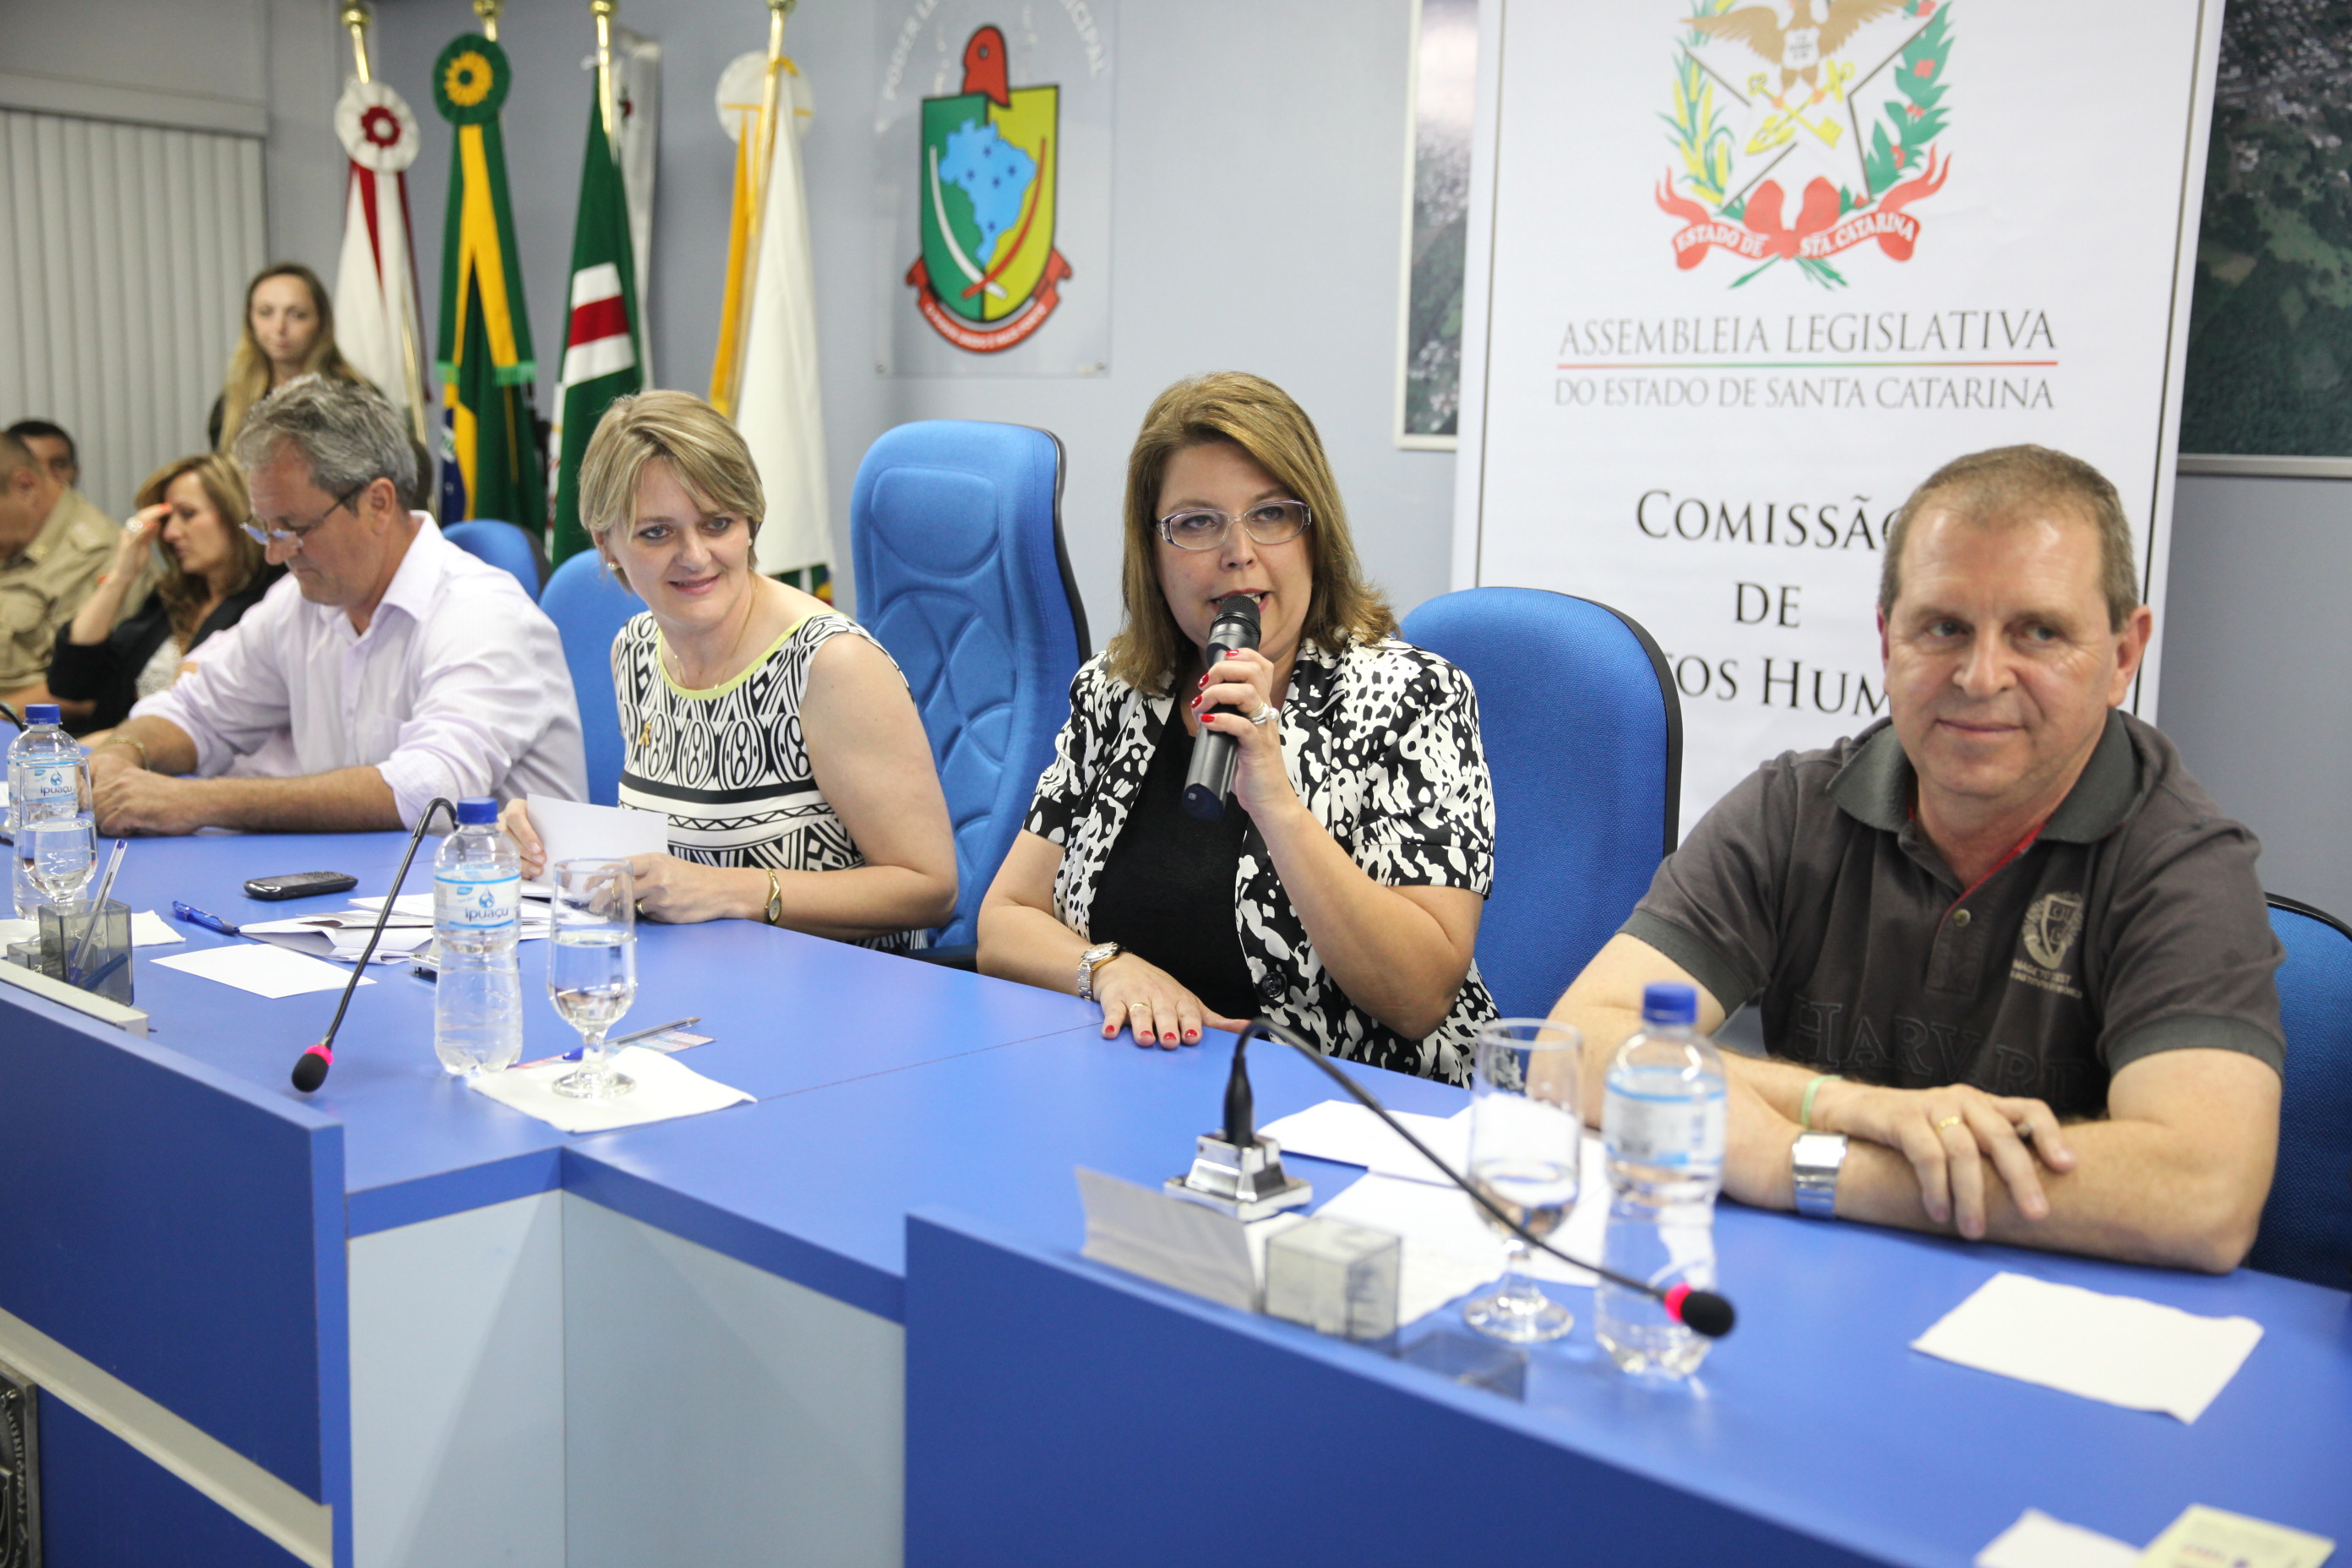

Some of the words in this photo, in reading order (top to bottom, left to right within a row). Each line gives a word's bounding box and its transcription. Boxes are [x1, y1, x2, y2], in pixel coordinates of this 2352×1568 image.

[1675, 223, 1740, 253] ESTADO
[1740, 235, 1766, 258] DE
[1835, 212, 1916, 247] CATARINA
[1558, 316, 1770, 357] ASSEMBLEIA
[1784, 308, 2059, 355] LEGISLATIVA
[1554, 378, 1596, 408] DO
[1603, 378, 1710, 408] ESTADO
[1718, 378, 1757, 409] DE
[1765, 377, 1866, 410] SANTA
[1875, 376, 2056, 411] CATARINA
[1733, 580, 1802, 629] DE
[40, 786, 73, 796] ipuaçu
[465, 906, 509, 923] ipuaçu
